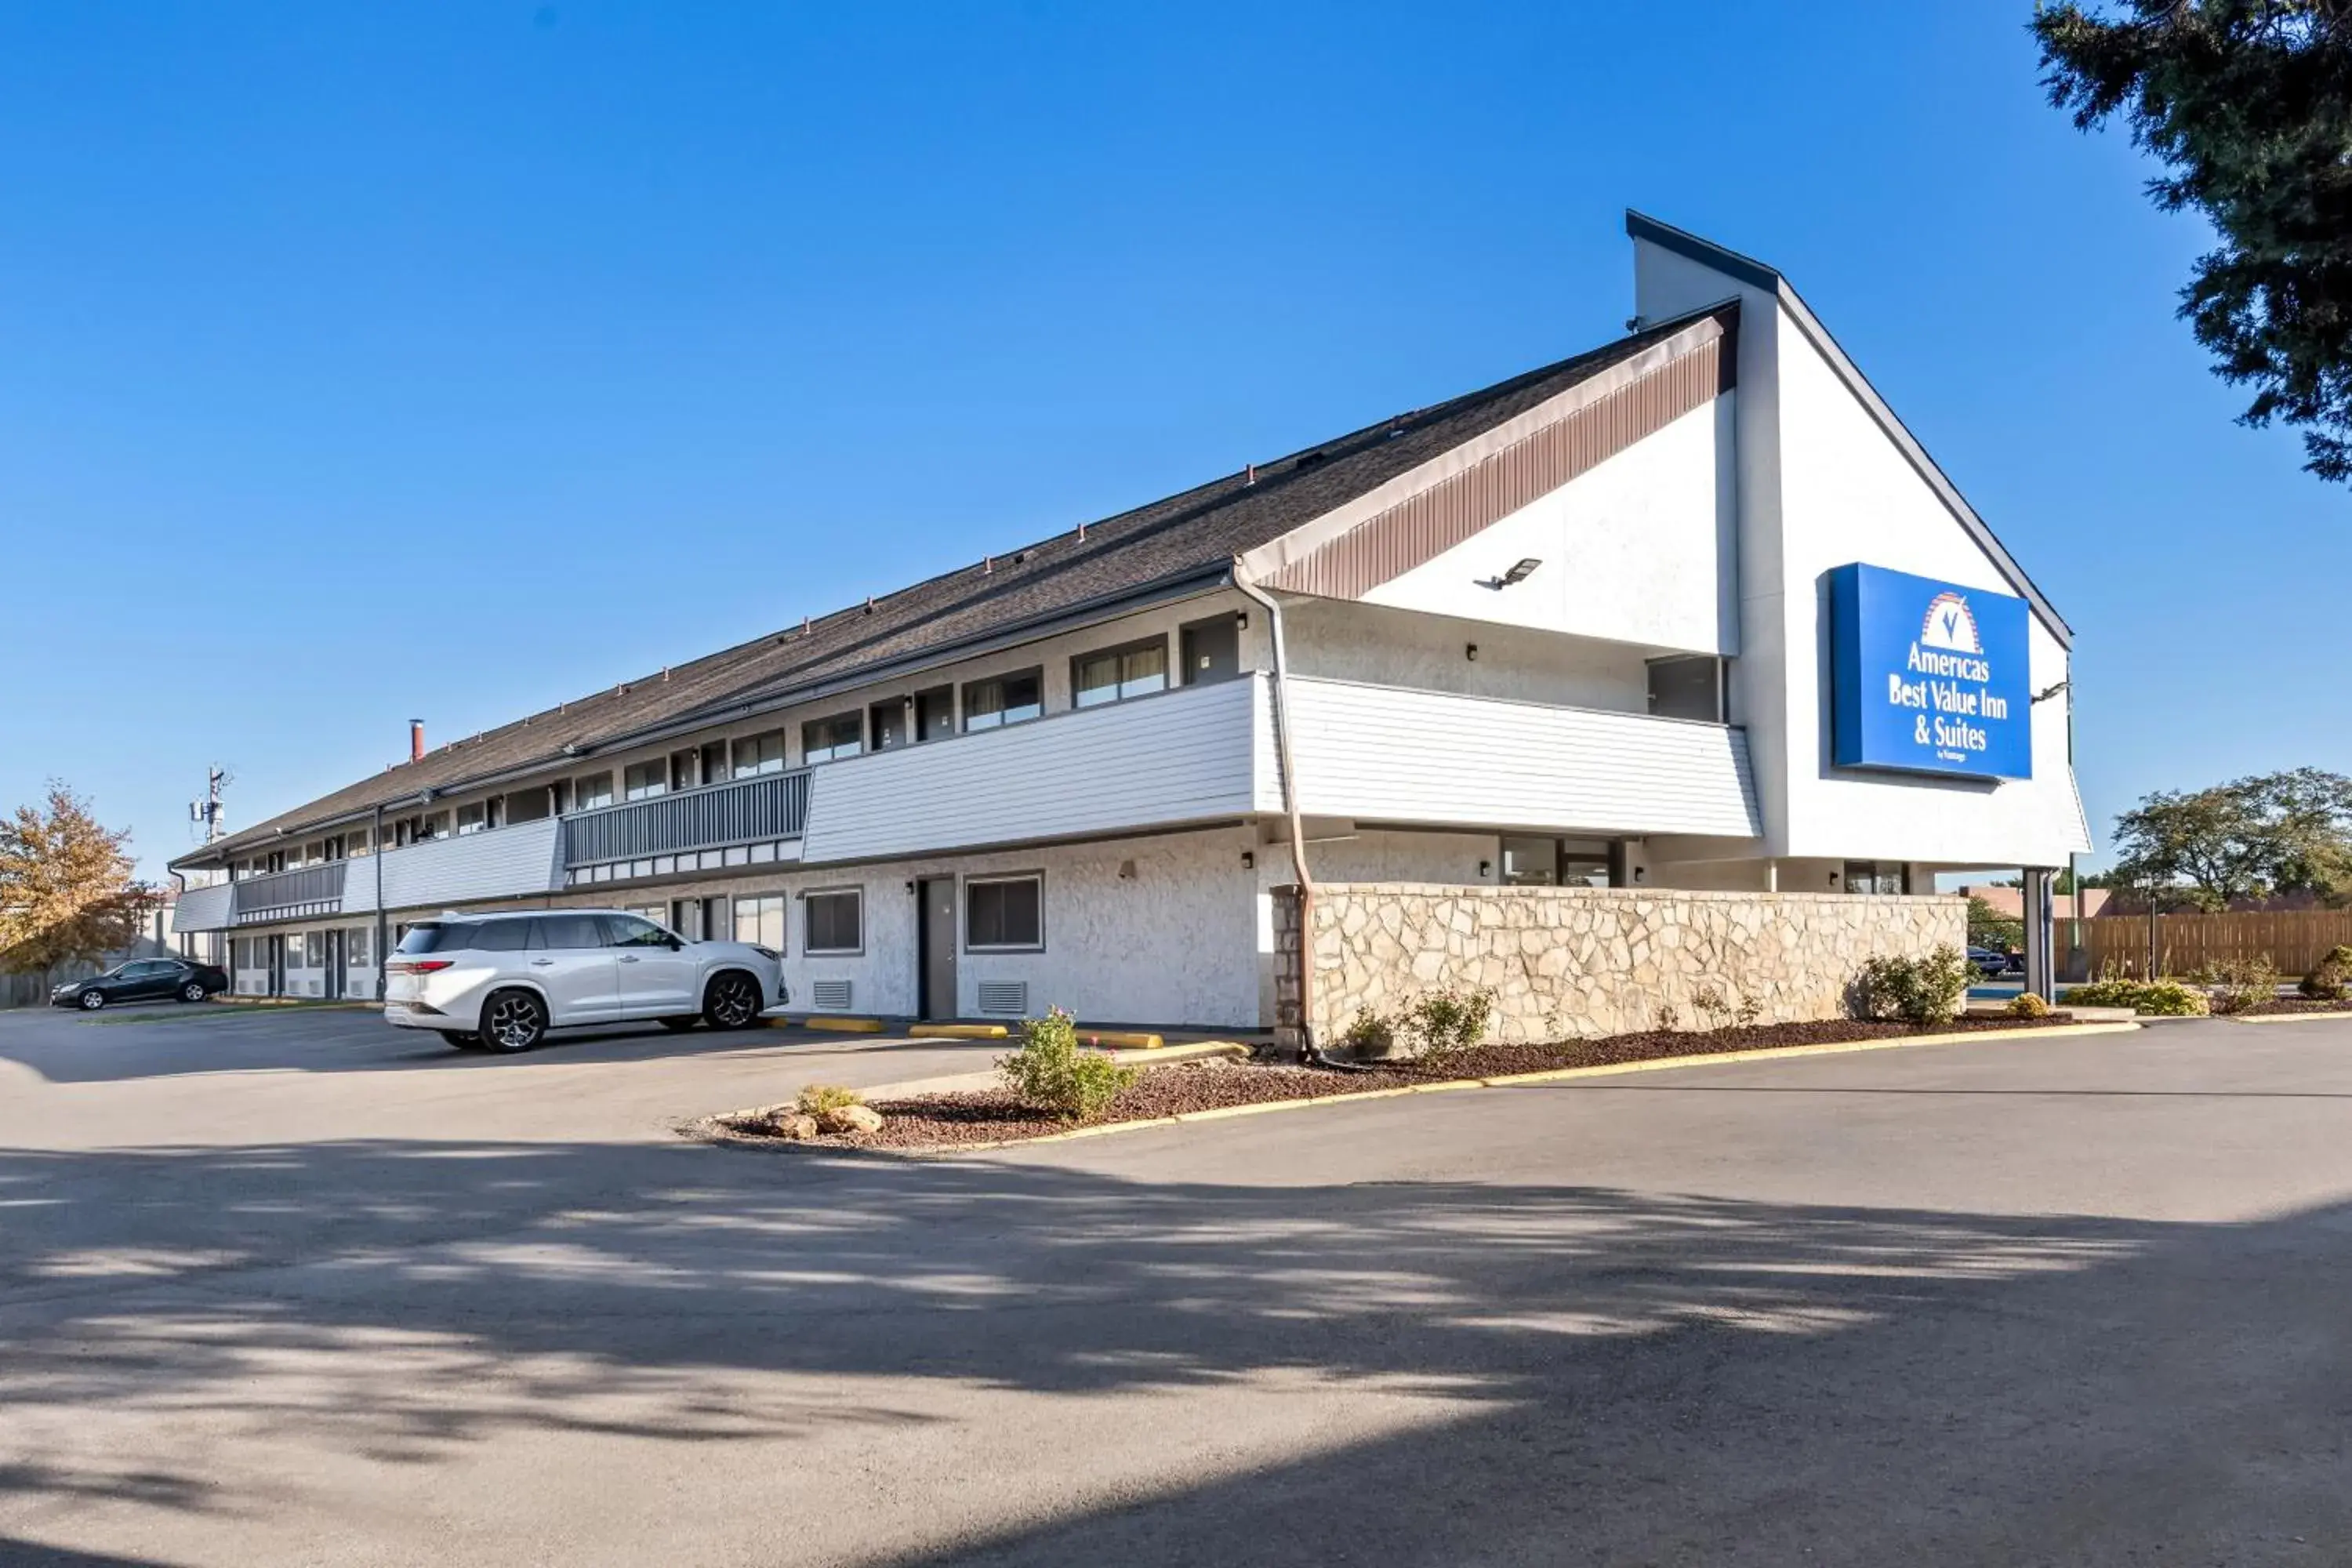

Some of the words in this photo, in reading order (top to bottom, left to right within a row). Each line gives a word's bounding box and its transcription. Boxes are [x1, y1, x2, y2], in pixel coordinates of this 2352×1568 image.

[1907, 641, 1989, 683] Americas
[1889, 673, 1927, 709] Best
[1930, 681, 1976, 715] Value
[1981, 688, 2007, 719] Inn
[1915, 714, 1929, 745] &
[1934, 716, 1986, 751] Suites
